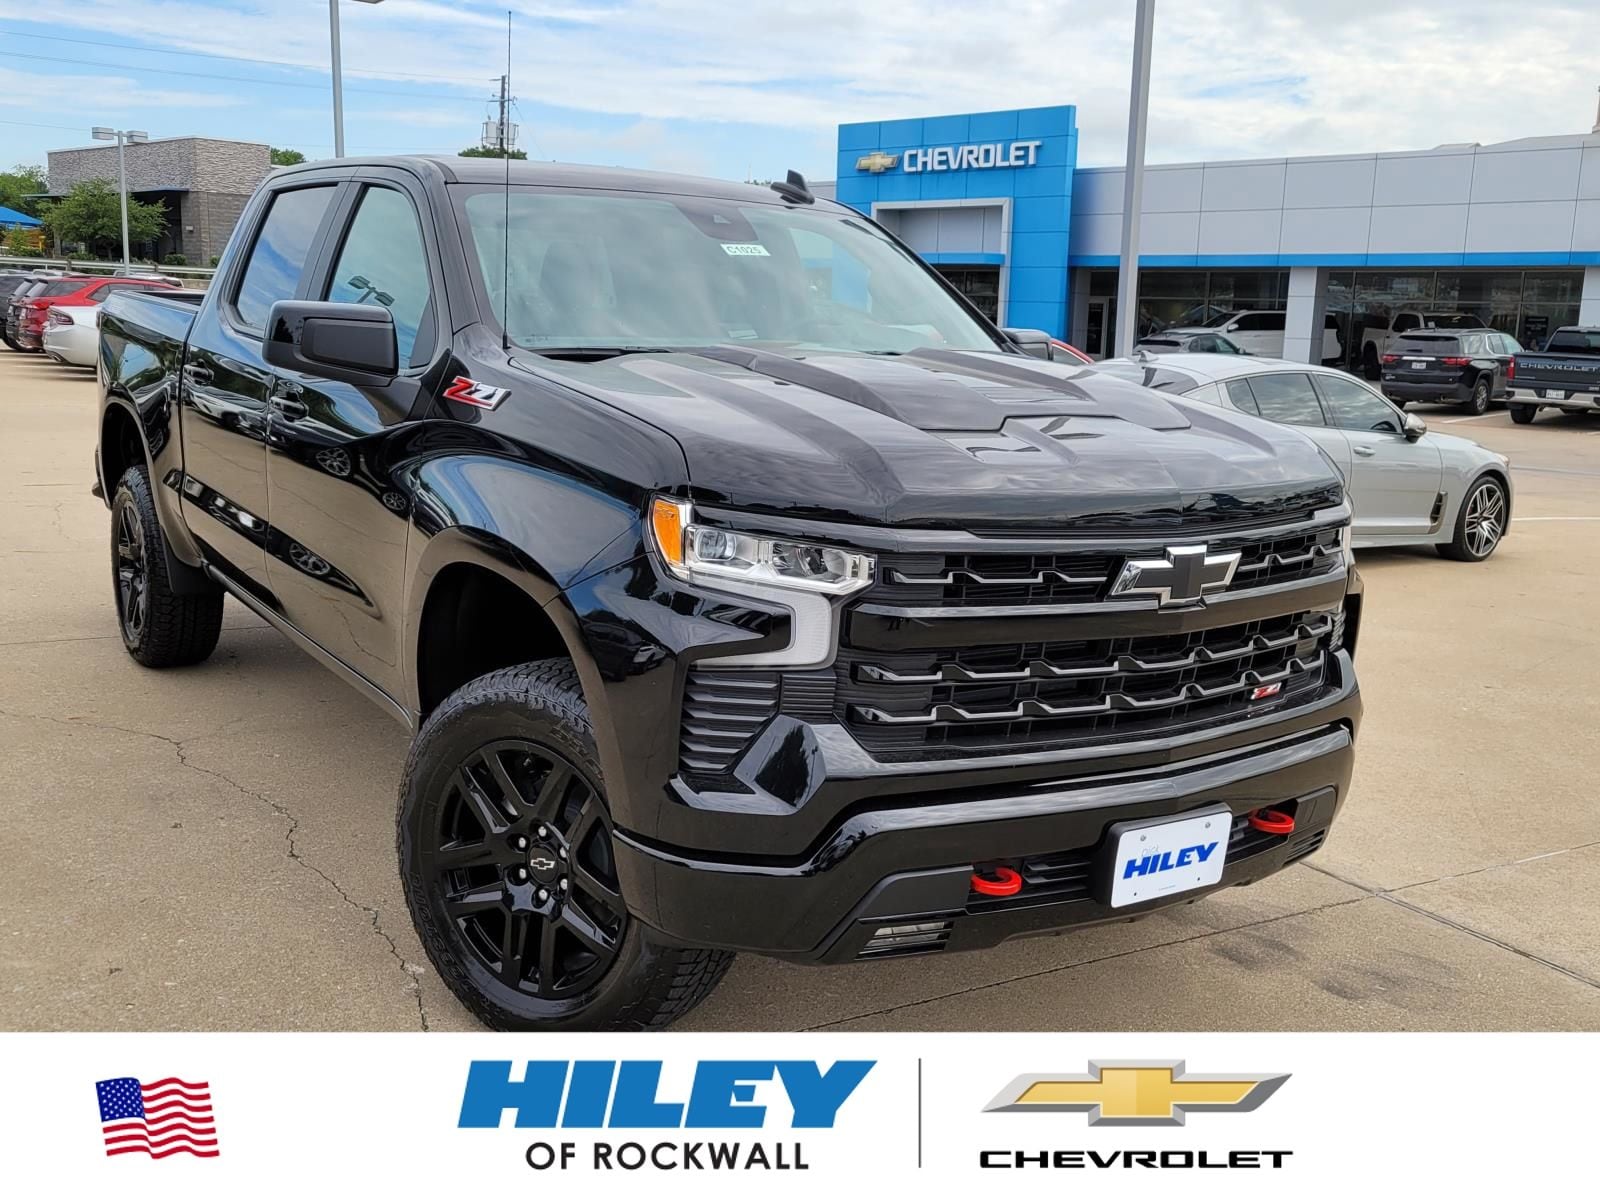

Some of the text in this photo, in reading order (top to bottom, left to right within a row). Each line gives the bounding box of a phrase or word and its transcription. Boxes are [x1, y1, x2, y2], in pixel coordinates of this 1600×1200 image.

[903, 141, 1043, 172] CHEVROLET
[1519, 362, 1598, 372] CHEVROLET
[442, 375, 512, 411] Z71
[1123, 842, 1218, 880] HILEY
